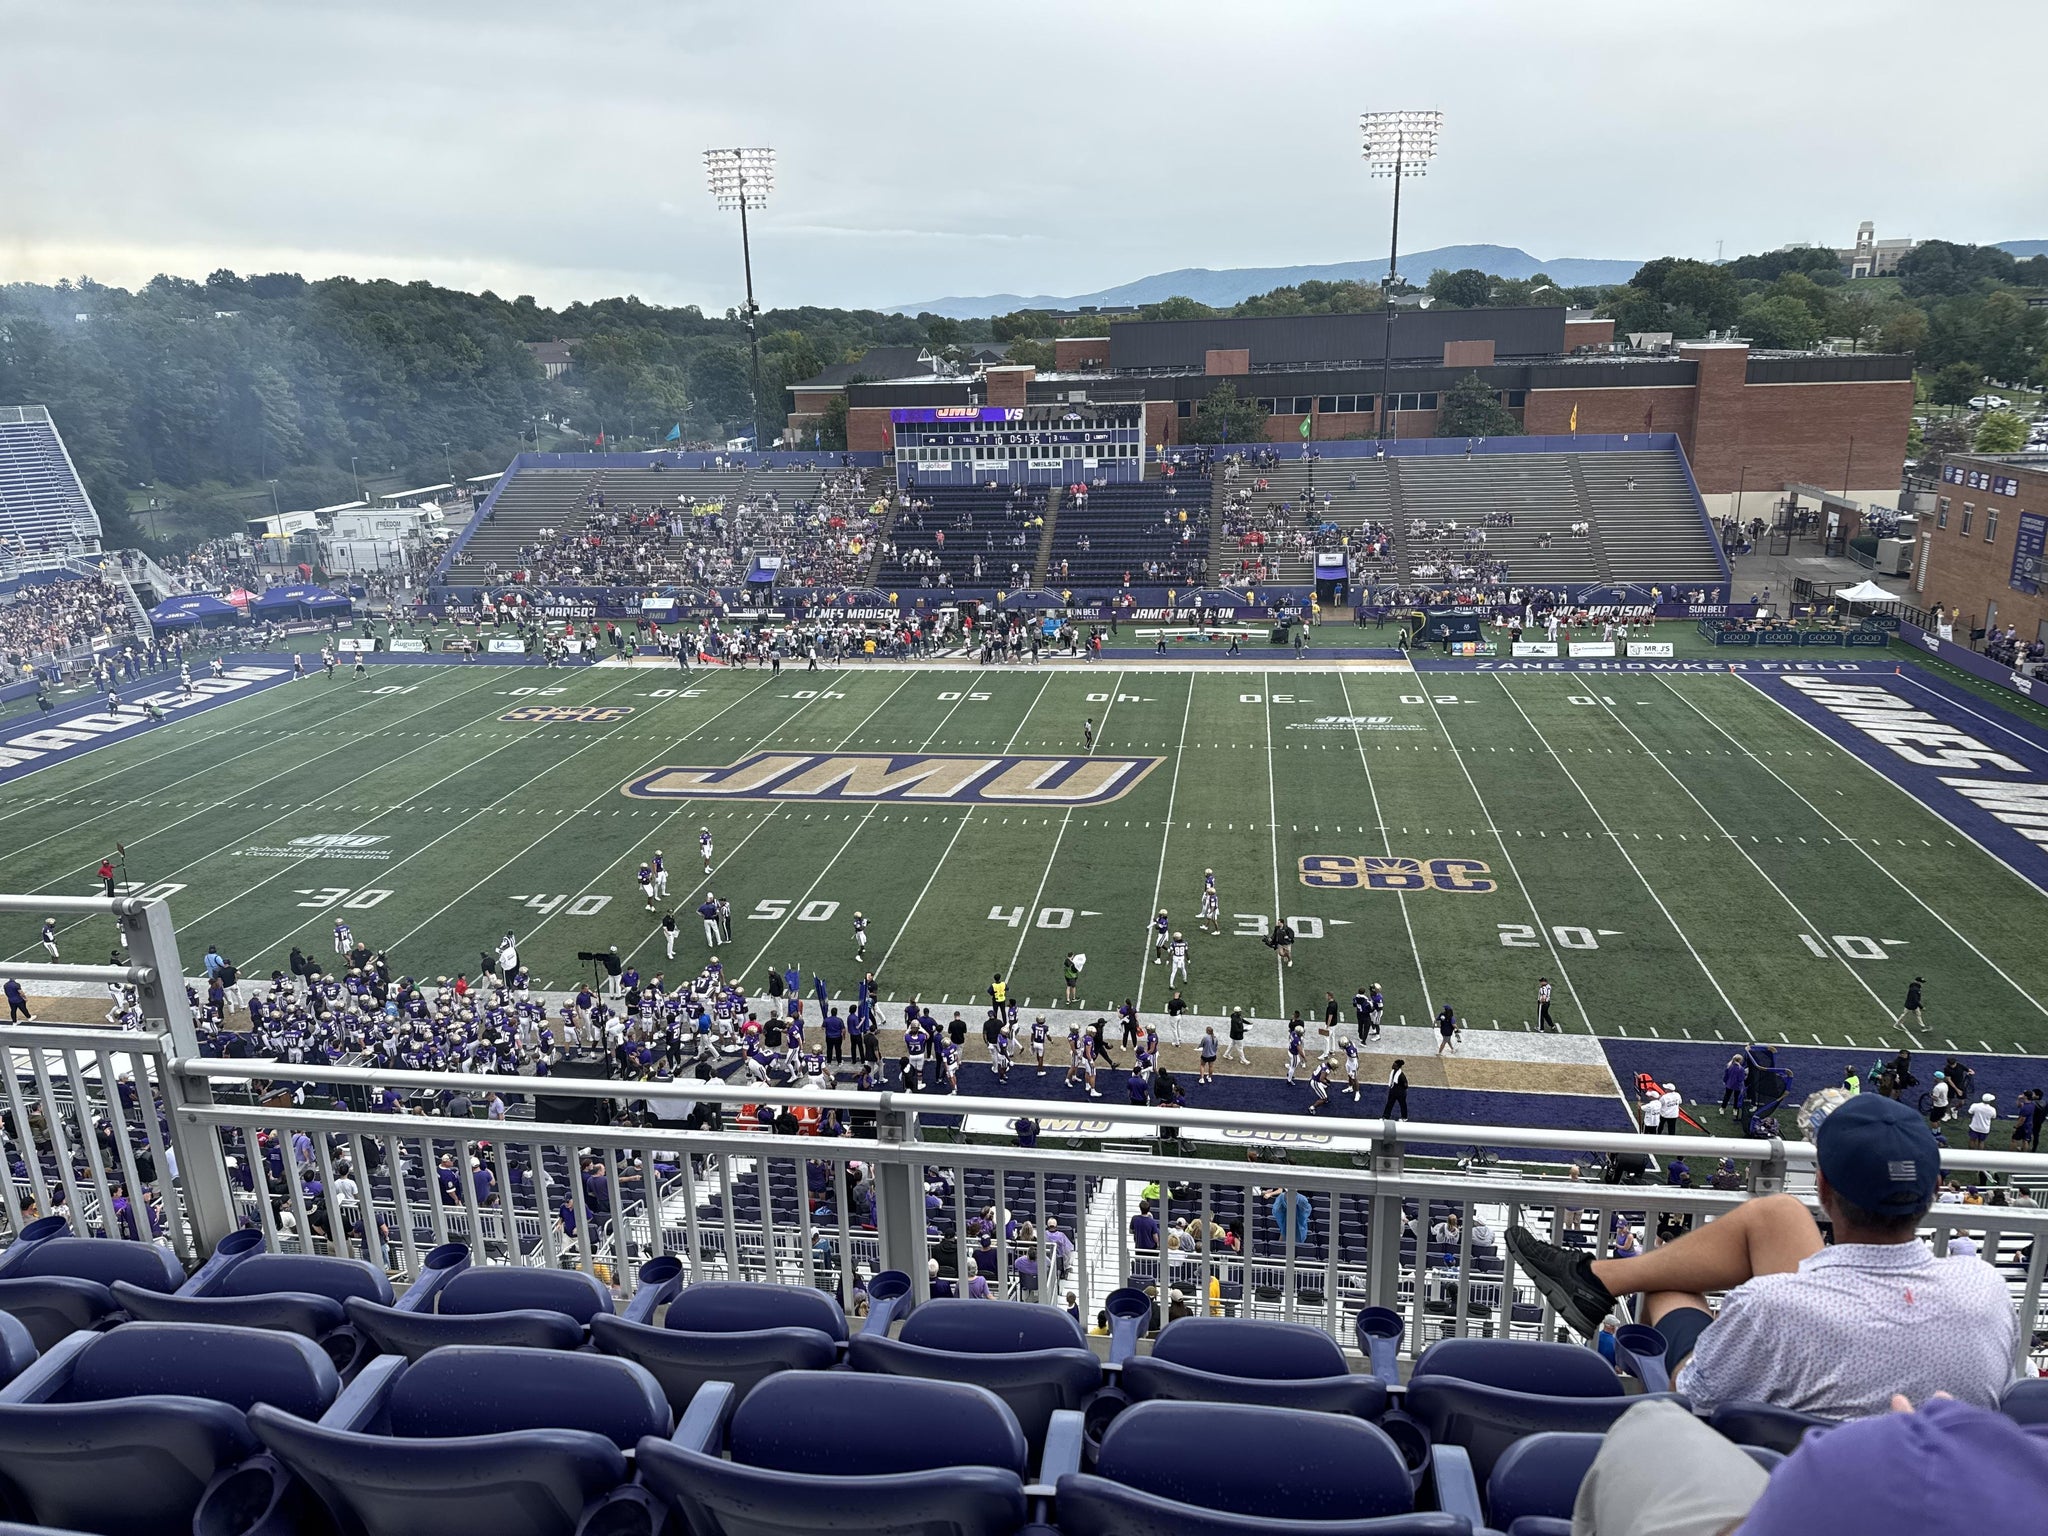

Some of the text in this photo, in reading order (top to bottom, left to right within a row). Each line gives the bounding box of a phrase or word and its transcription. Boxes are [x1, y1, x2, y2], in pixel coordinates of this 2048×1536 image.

[1004, 408, 1024, 421] VS
[376, 520, 401, 528] FREEDOM
[1083, 608, 1099, 616] BELT
[1285, 607, 1303, 615] BELT
[1689, 605, 1728, 614] SUN BELT
[1723, 633, 1750, 641] GOOD
[1765, 633, 1793, 641] GOOD
[1852, 634, 1881, 642] GOOD
[1578, 662, 1749, 670] SHOWKER
[1761, 663, 1861, 671] FIELD
[498, 706, 635, 722] SBC
[1780, 675, 2033, 773] JAMES
[628, 752, 1160, 804] JMU
[287, 833, 392, 848] JMU
[245, 851, 320, 859] Continuing
[1298, 855, 1498, 893] SBC
[296, 887, 395, 909] 30
[523, 894, 613, 916] 40
[747, 899, 840, 922] 50
[987, 905, 1074, 929] 40
[1232, 913, 1324, 939] 30
[1496, 923, 1600, 949] 20
[1798, 933, 1889, 960] 10
[1034, 1030, 1044, 1040] 14
[371, 1094, 383, 1104] 73
